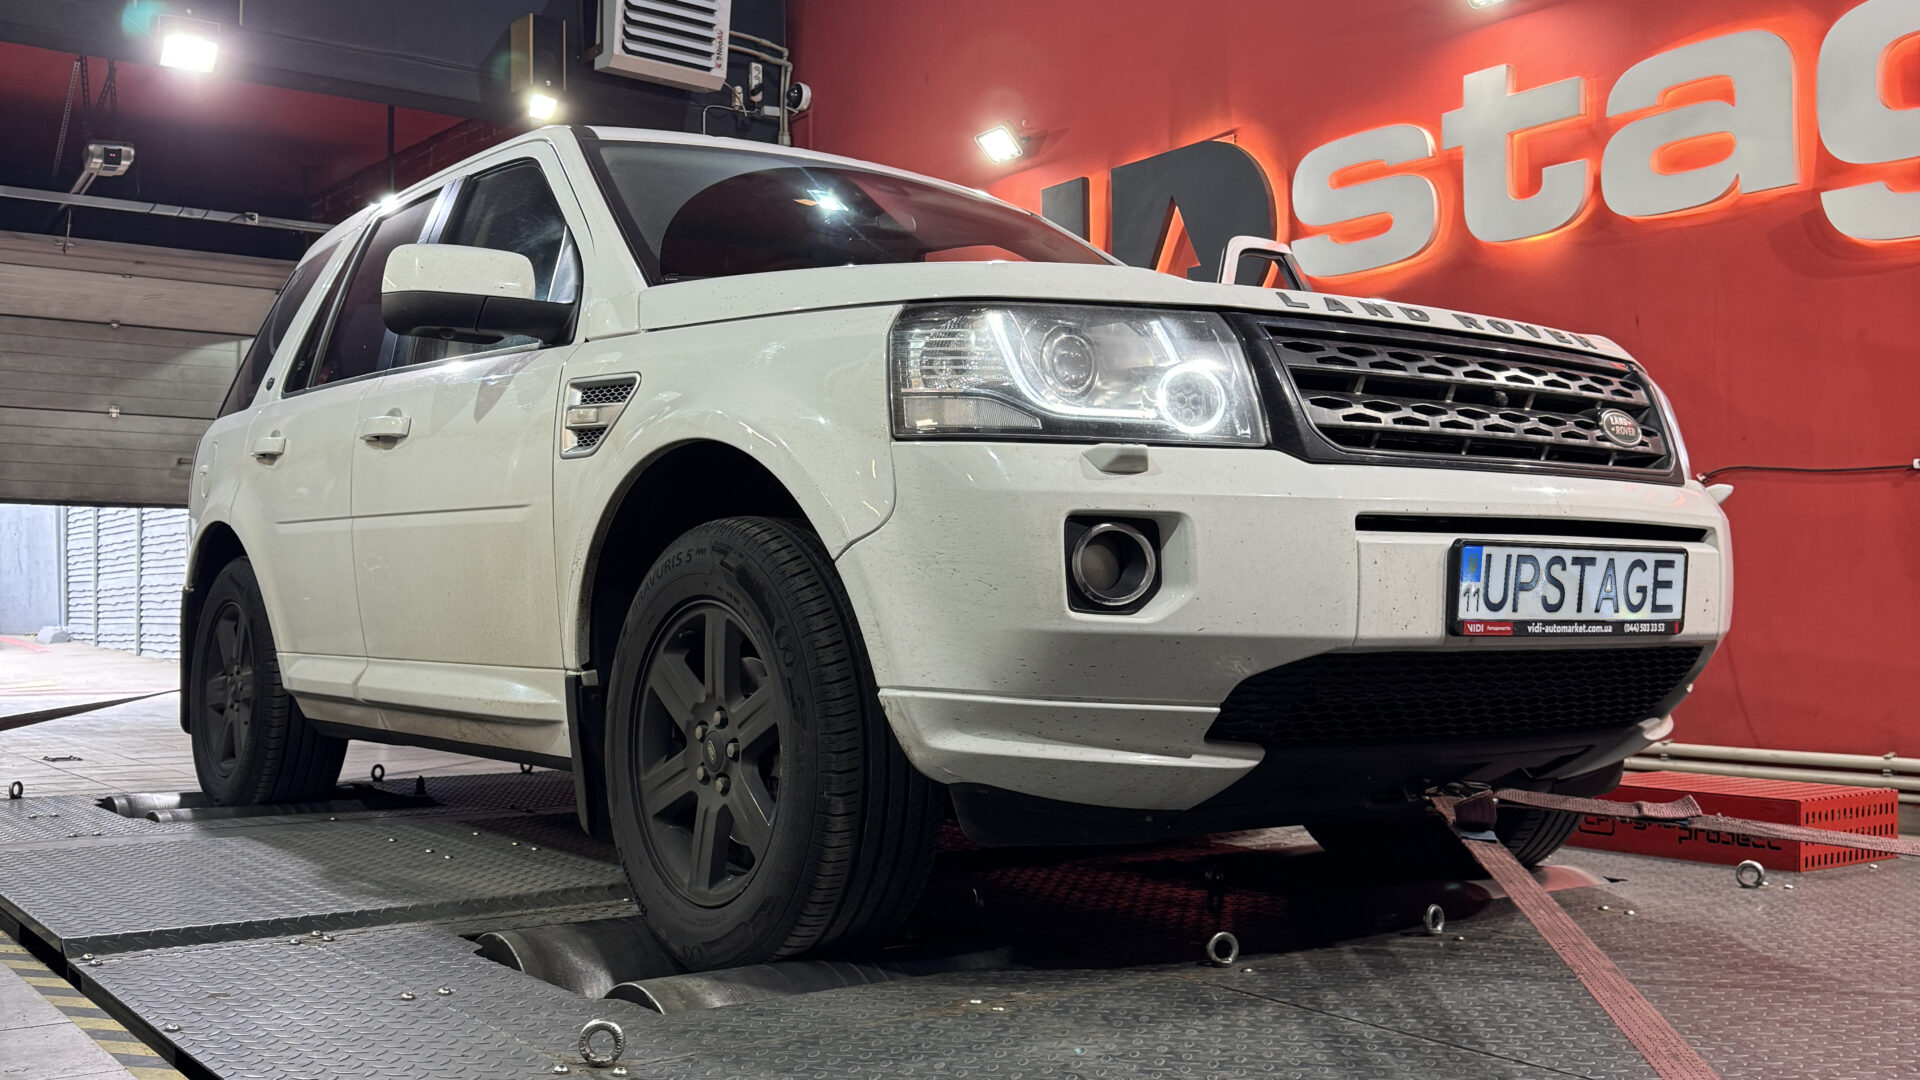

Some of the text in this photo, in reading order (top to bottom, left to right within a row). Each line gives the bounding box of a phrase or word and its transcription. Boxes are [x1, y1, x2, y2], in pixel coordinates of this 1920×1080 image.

[1276, 291, 1598, 350] LAND ROVER
[1609, 415, 1628, 426] LAND
[1615, 426, 1636, 437] ROVER
[685, 549, 694, 564] 5
[1483, 553, 1676, 613] UPSTAGE
[1462, 585, 1481, 612] 11
[1467, 623, 1484, 633] VIDI
[1527, 623, 1613, 633] vidi-automarket.com.ua
[1623, 623, 1639, 633] (044)
[1640, 623, 1650, 633] 503
